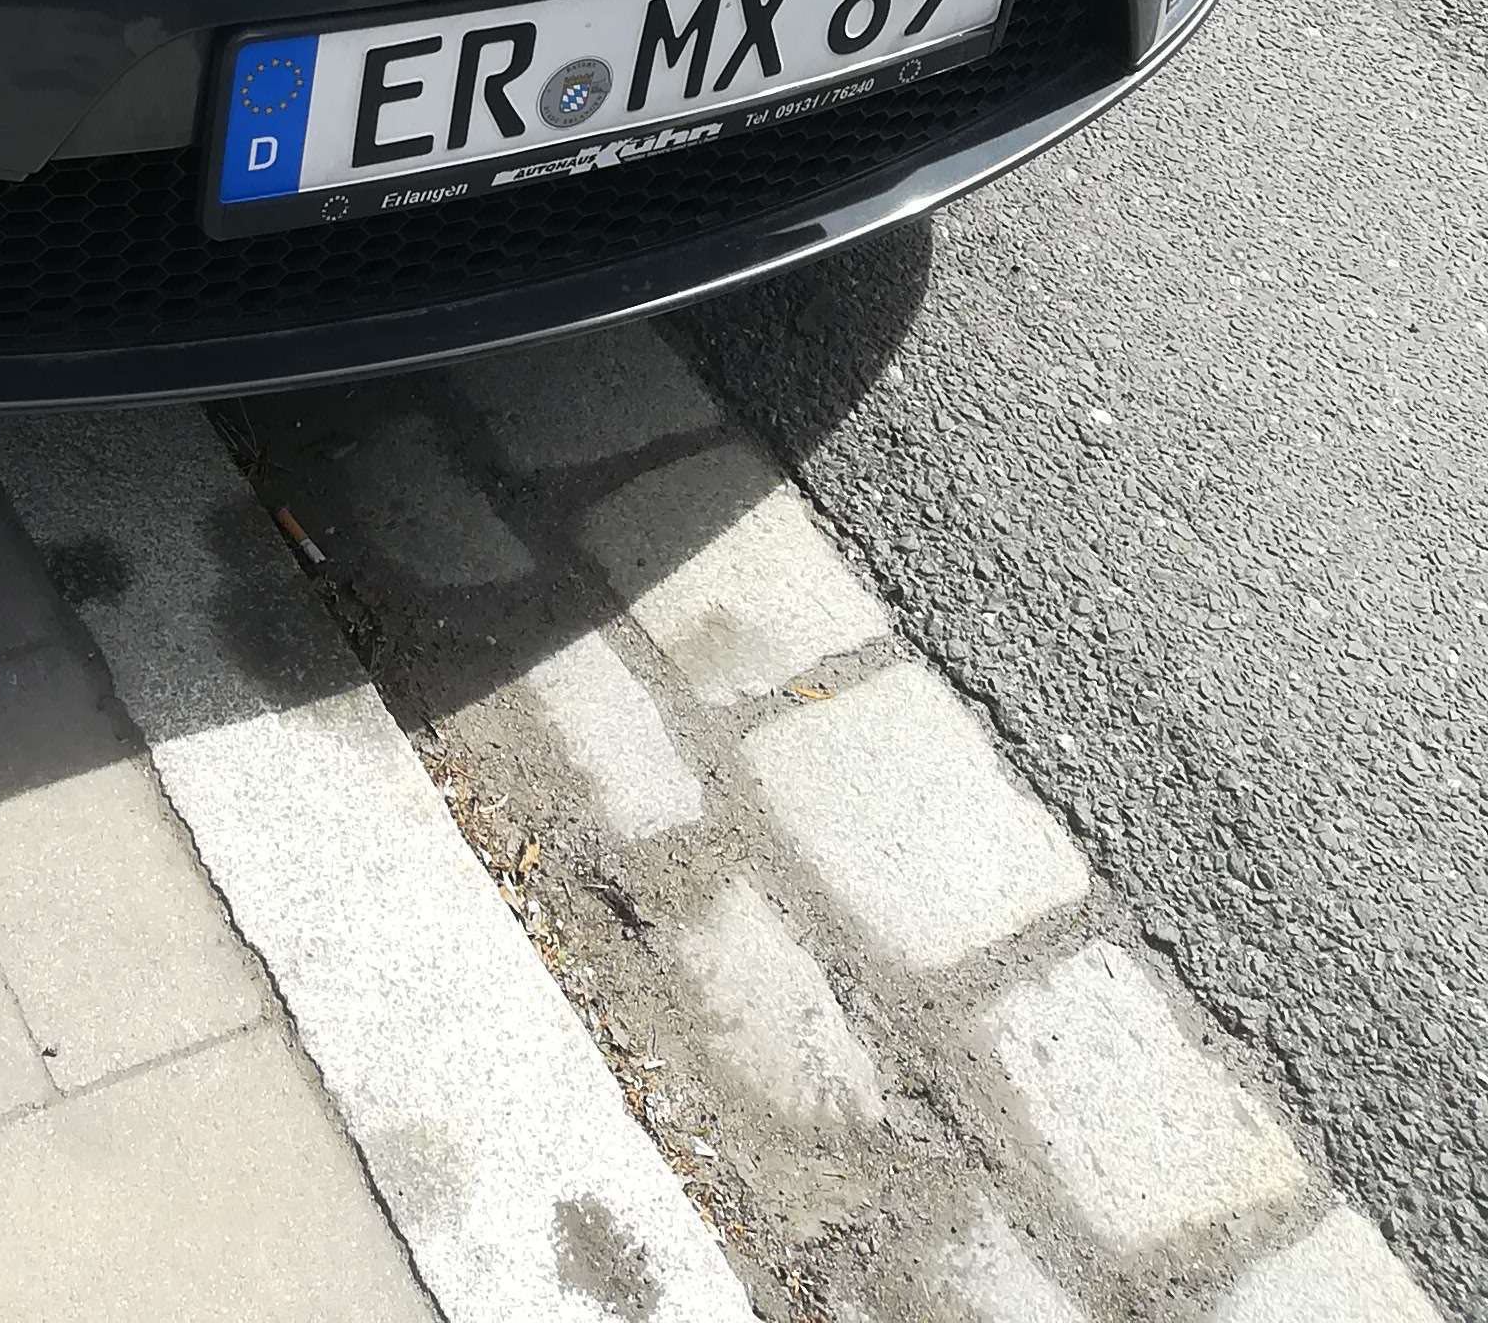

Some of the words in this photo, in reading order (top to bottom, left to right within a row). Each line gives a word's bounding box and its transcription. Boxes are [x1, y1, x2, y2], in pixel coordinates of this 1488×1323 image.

[351, 19, 538, 169] ER
[247, 135, 279, 172] D
[513, 154, 597, 181] AUTOHAUS
[569, 123, 724, 176] Kühn
[380, 183, 469, 209] Erlangen
